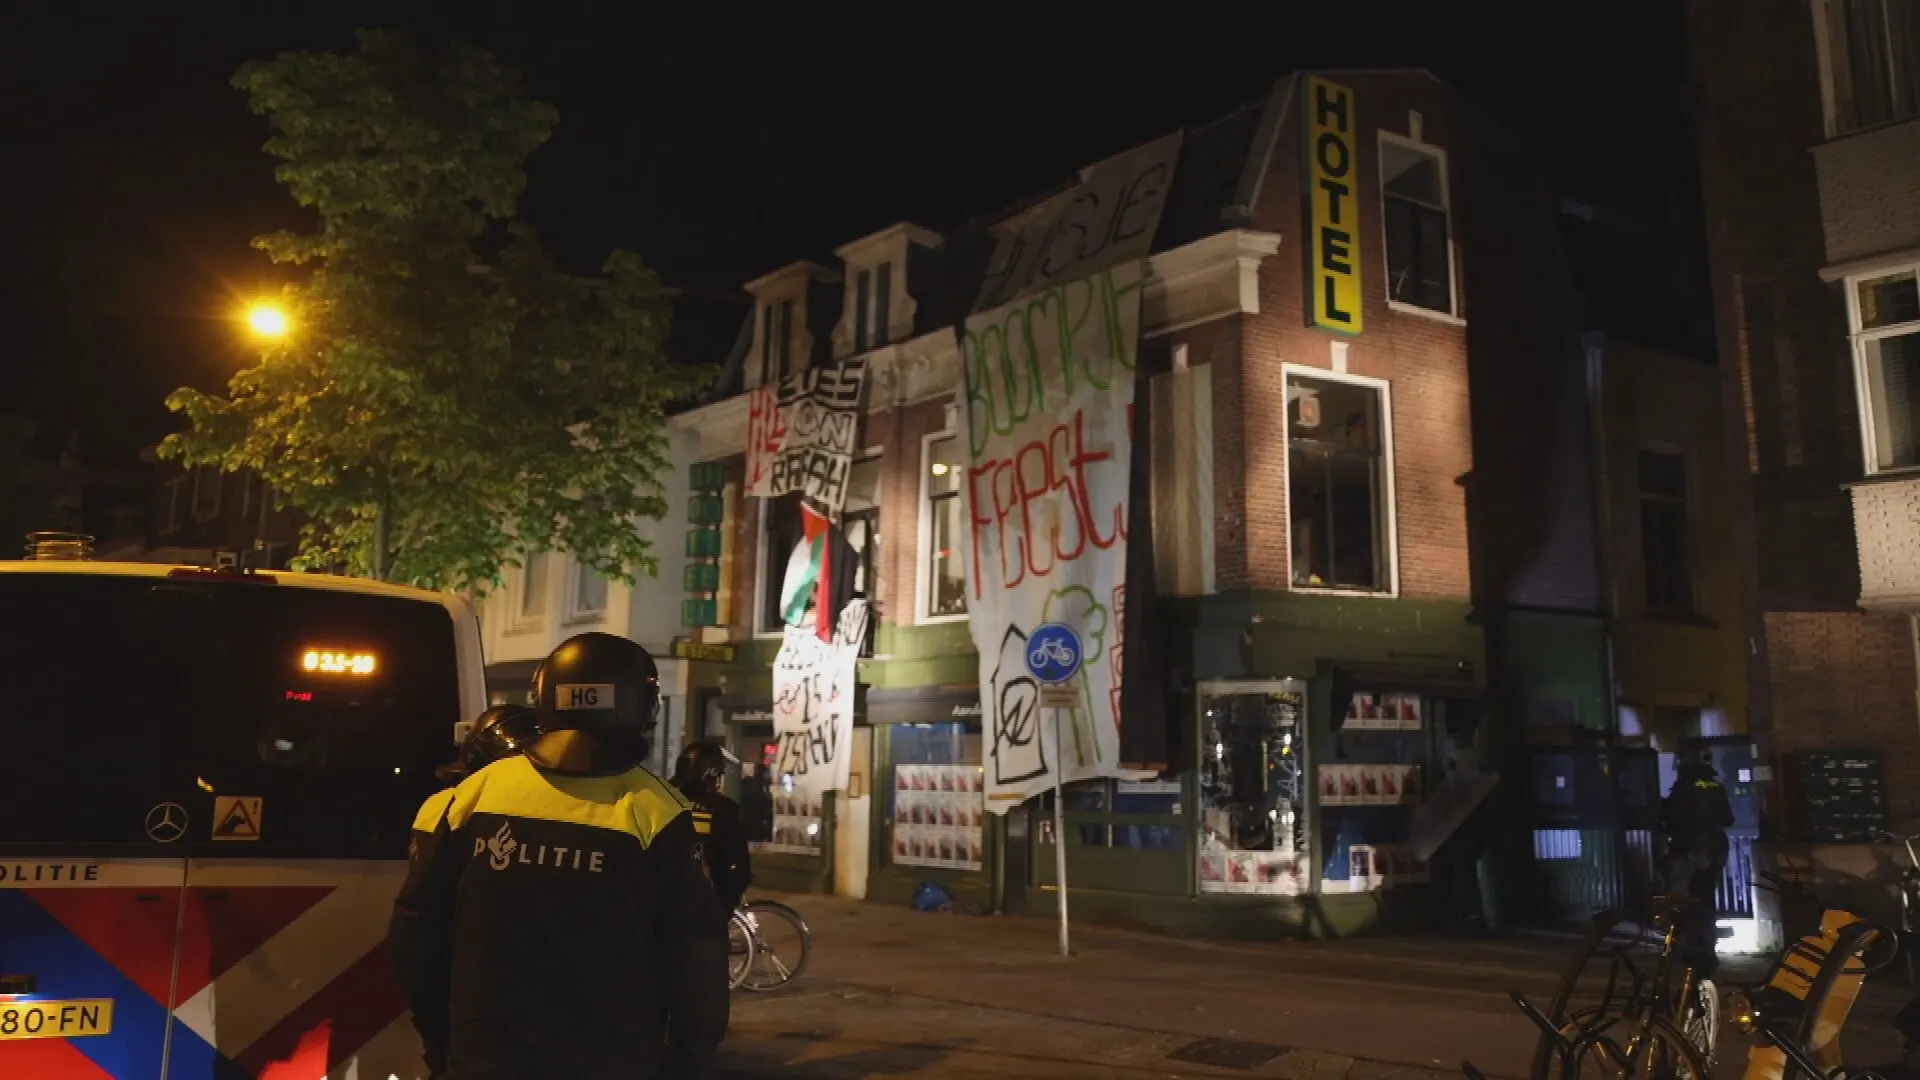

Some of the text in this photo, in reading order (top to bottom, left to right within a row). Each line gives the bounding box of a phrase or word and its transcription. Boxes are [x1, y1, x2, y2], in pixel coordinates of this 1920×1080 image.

[1316, 84, 1352, 324] HOTEL
[571, 688, 598, 707] HG
[474, 820, 605, 872] POLITIE
[1, 1006, 99, 1034] 80-FN
